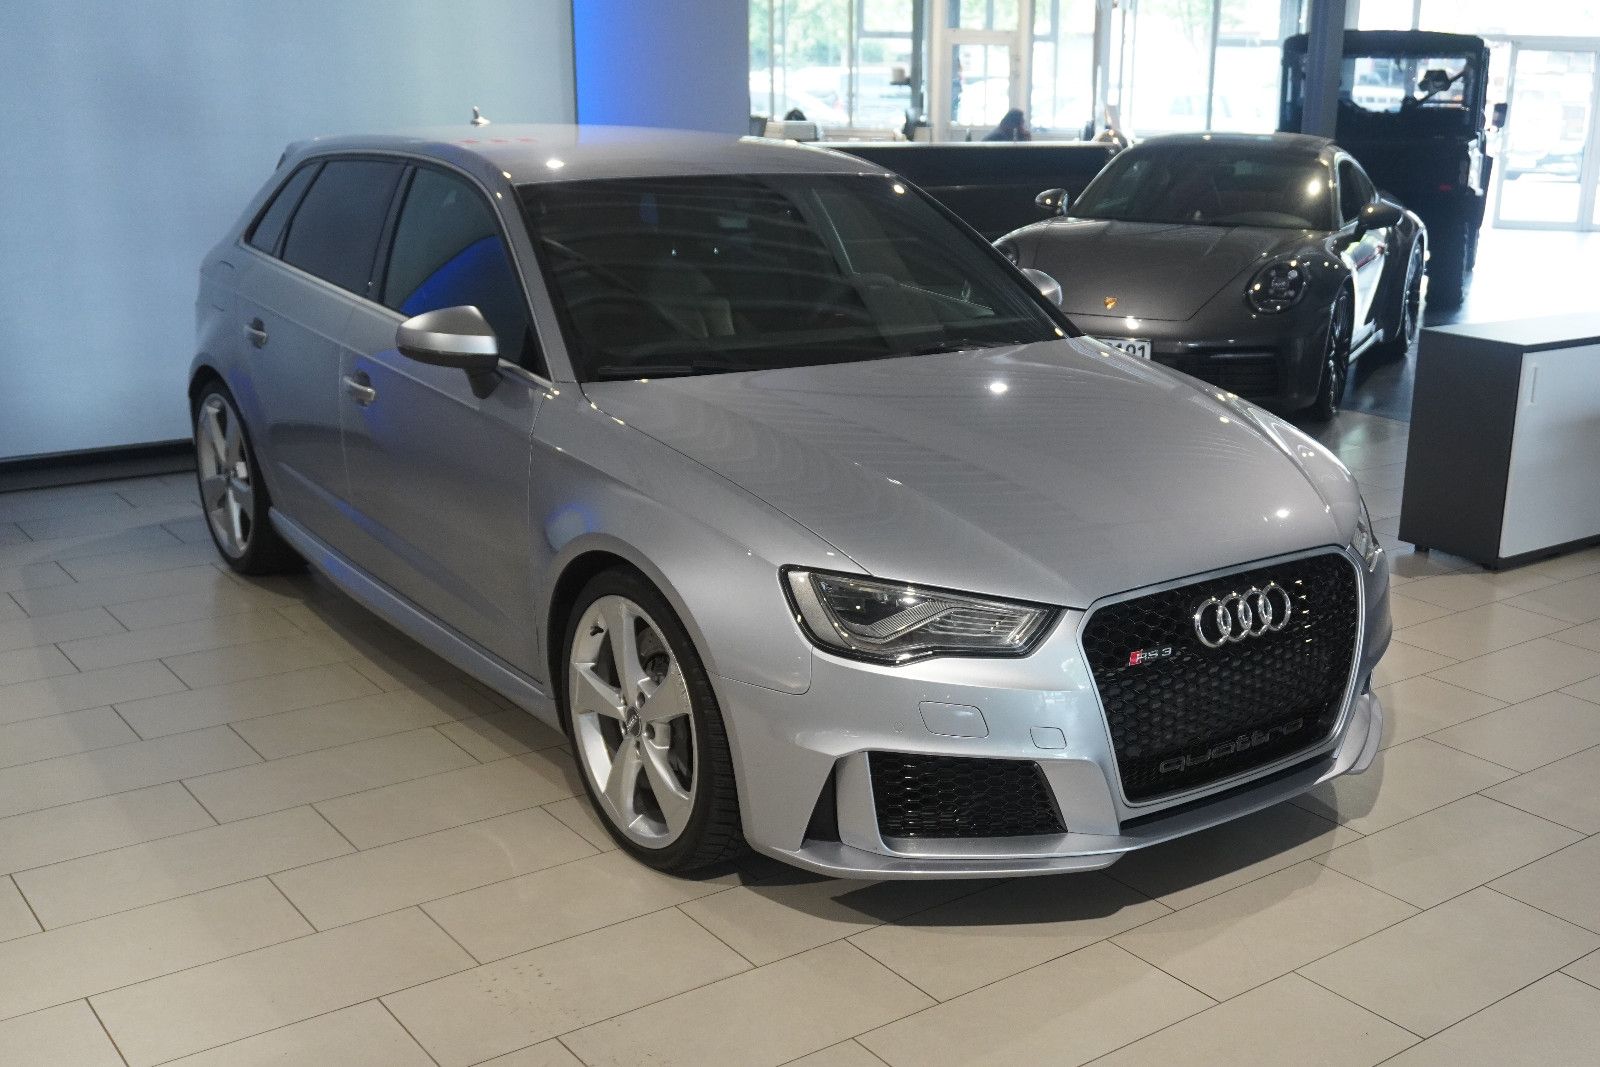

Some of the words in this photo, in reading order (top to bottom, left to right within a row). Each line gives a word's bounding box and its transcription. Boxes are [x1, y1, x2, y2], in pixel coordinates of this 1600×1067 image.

[1133, 649, 1159, 664] RS
[1161, 647, 1172, 657] 3
[1159, 717, 1304, 773] quattro
